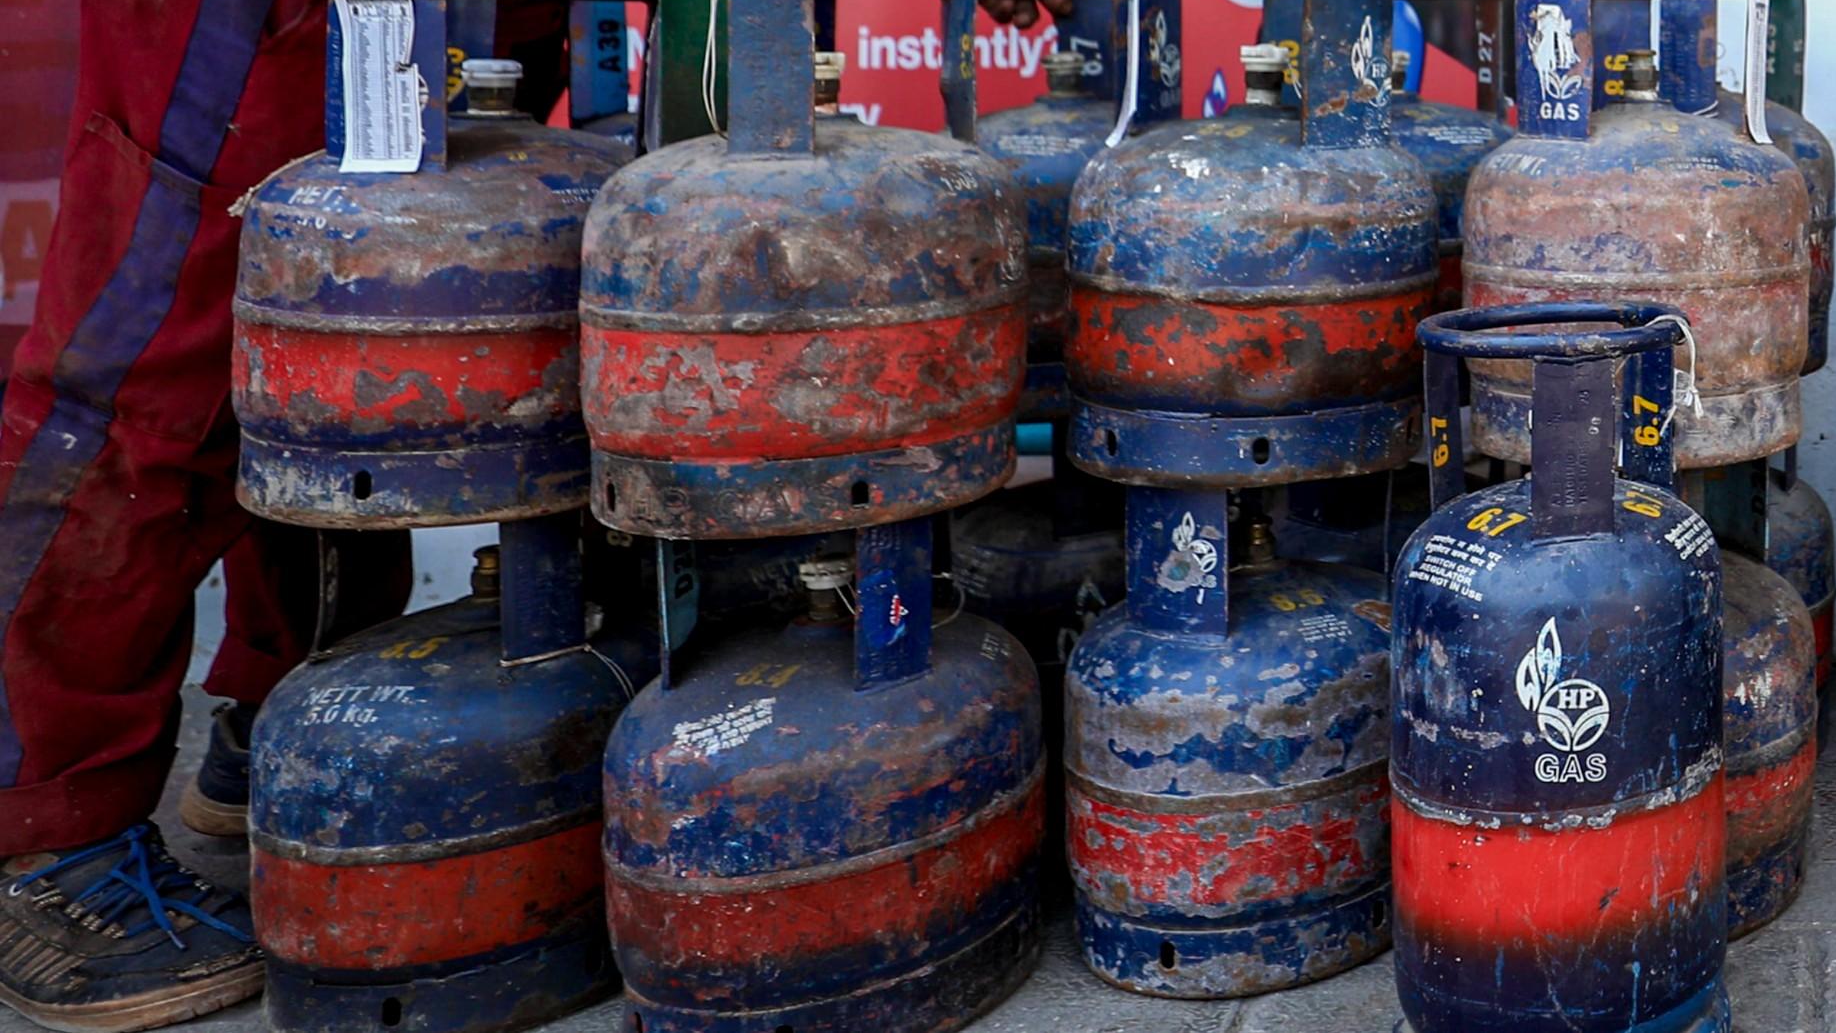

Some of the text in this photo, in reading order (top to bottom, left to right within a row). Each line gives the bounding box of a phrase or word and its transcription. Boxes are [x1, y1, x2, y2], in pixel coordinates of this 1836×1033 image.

[1540, 103, 1581, 121] GAS
[1632, 394, 1662, 447] 6.7
[1430, 416, 1449, 467] 6.7
[1467, 508, 1528, 537] 6.7
[1419, 562, 1473, 587] REGULATOR
[1425, 554, 1477, 577] SWITCH OFF
[1408, 570, 1484, 603] WHEN NOT IN USE
[302, 685, 371, 708] NETT
[1557, 688, 1595, 710] HP
[303, 704, 342, 726] 5.0
[1534, 752, 1608, 783] GAS
